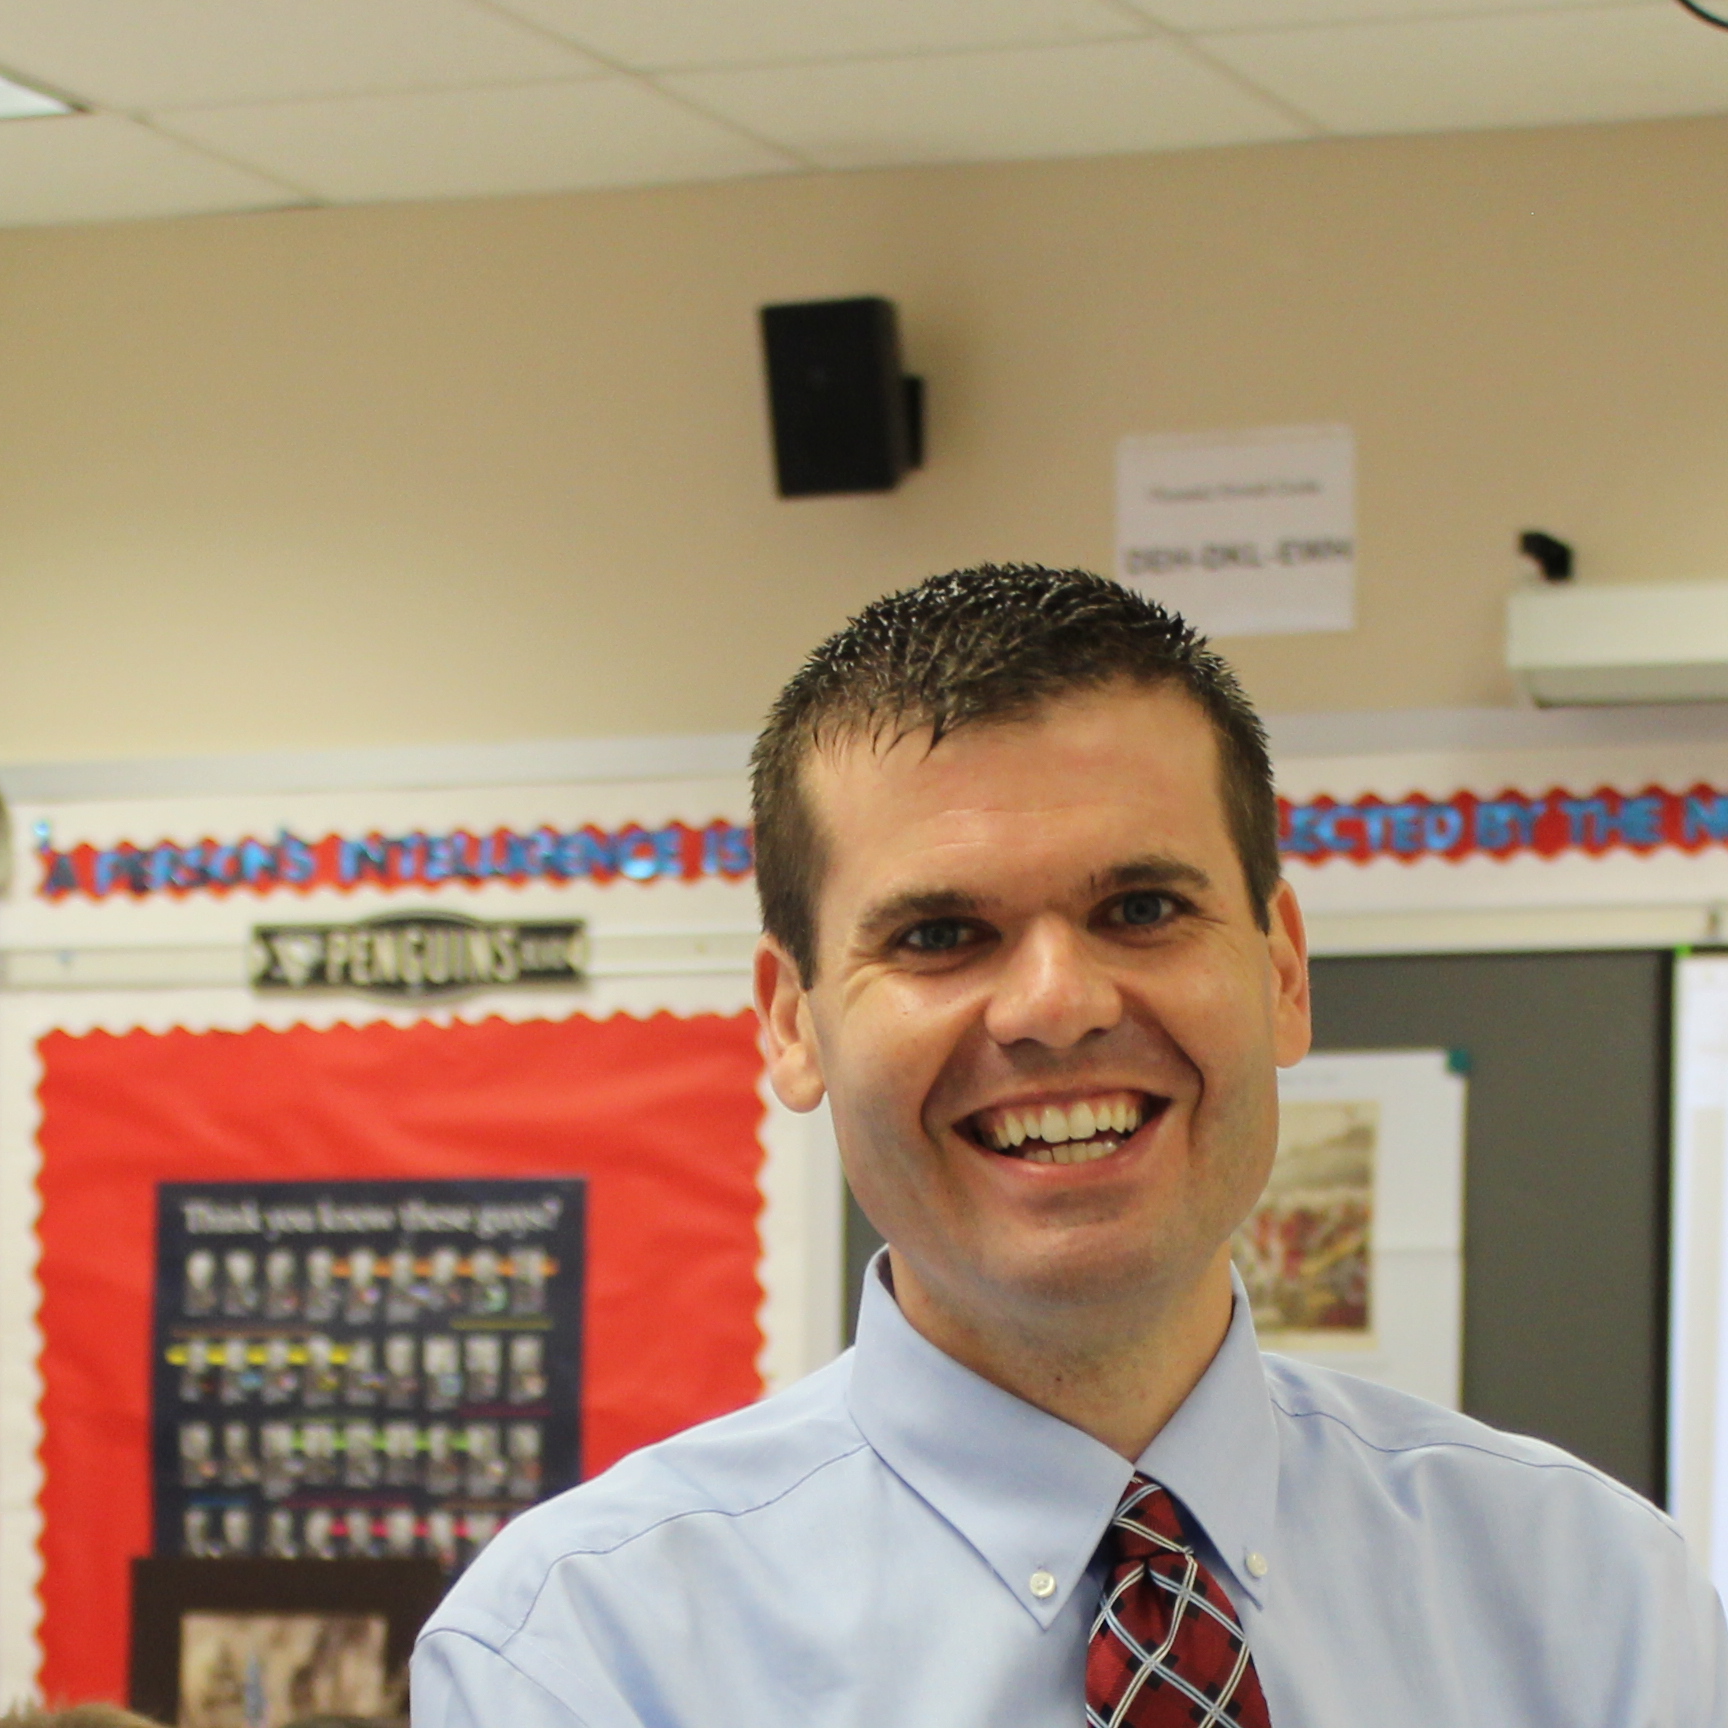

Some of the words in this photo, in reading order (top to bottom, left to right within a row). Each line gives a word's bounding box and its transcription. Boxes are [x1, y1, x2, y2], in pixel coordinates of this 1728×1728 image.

[340, 828, 682, 885] INTELLIGENCE
[1278, 800, 1464, 854] ECTED
[1474, 798, 1546, 850] BY
[1562, 797, 1664, 845] THE
[325, 924, 522, 986] PENGUINS
[183, 1198, 263, 1235] Think
